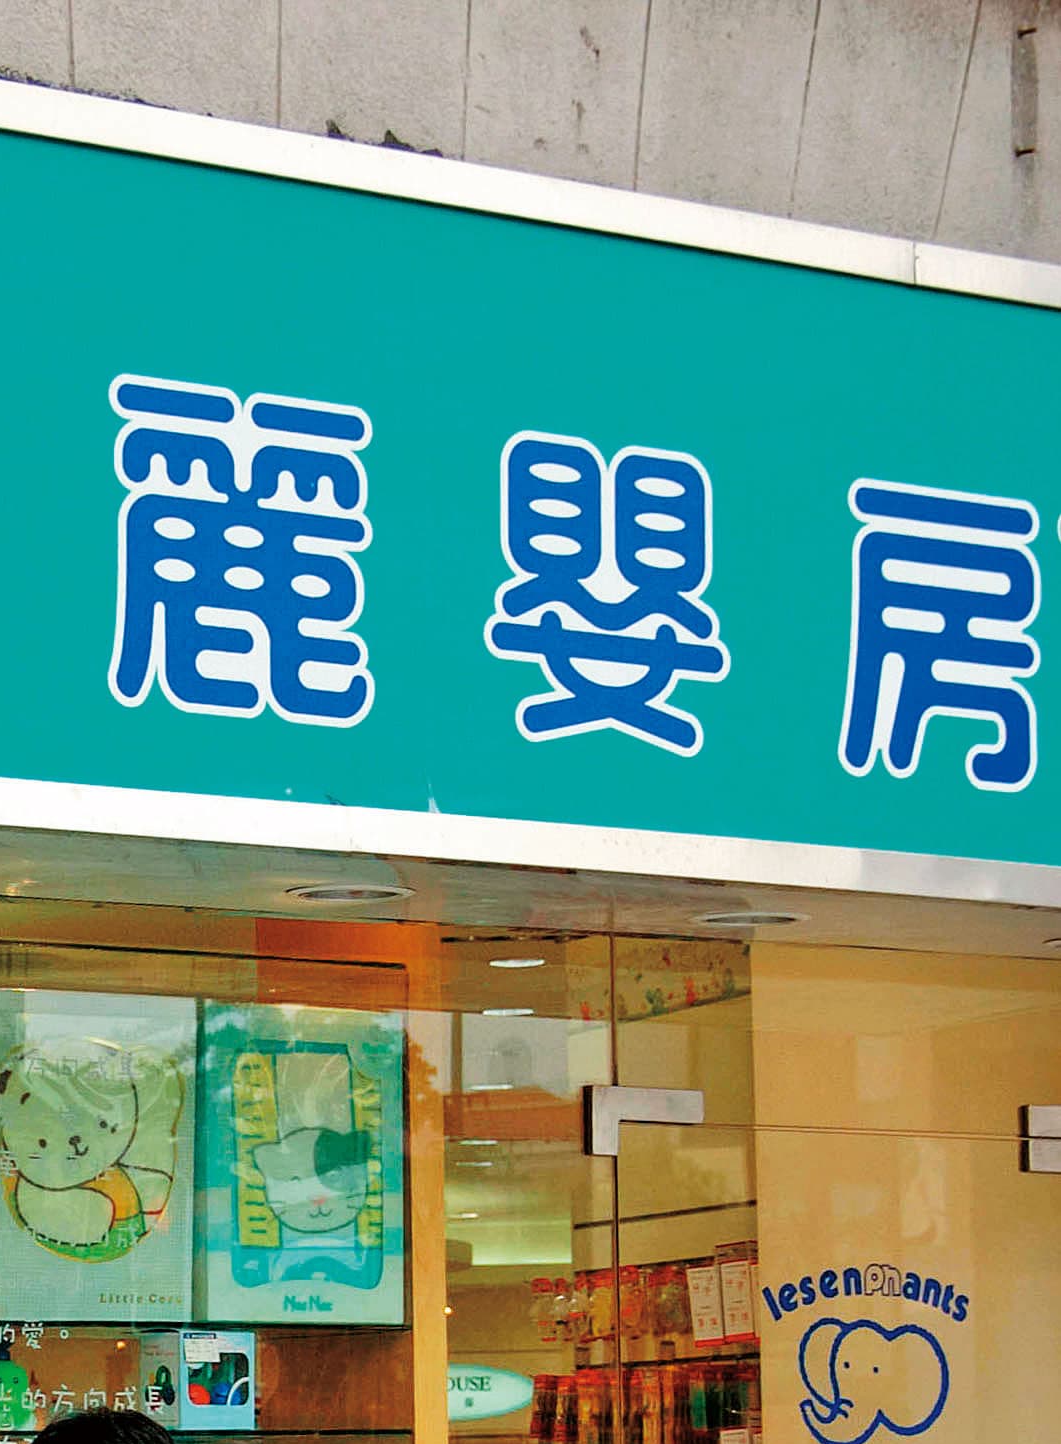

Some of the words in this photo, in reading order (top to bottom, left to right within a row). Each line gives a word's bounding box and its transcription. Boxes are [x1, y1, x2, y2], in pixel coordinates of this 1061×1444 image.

[108, 373, 1041, 793] 麗嬰房
[762, 1276, 816, 1321] les
[819, 1263, 969, 1322] enphants
